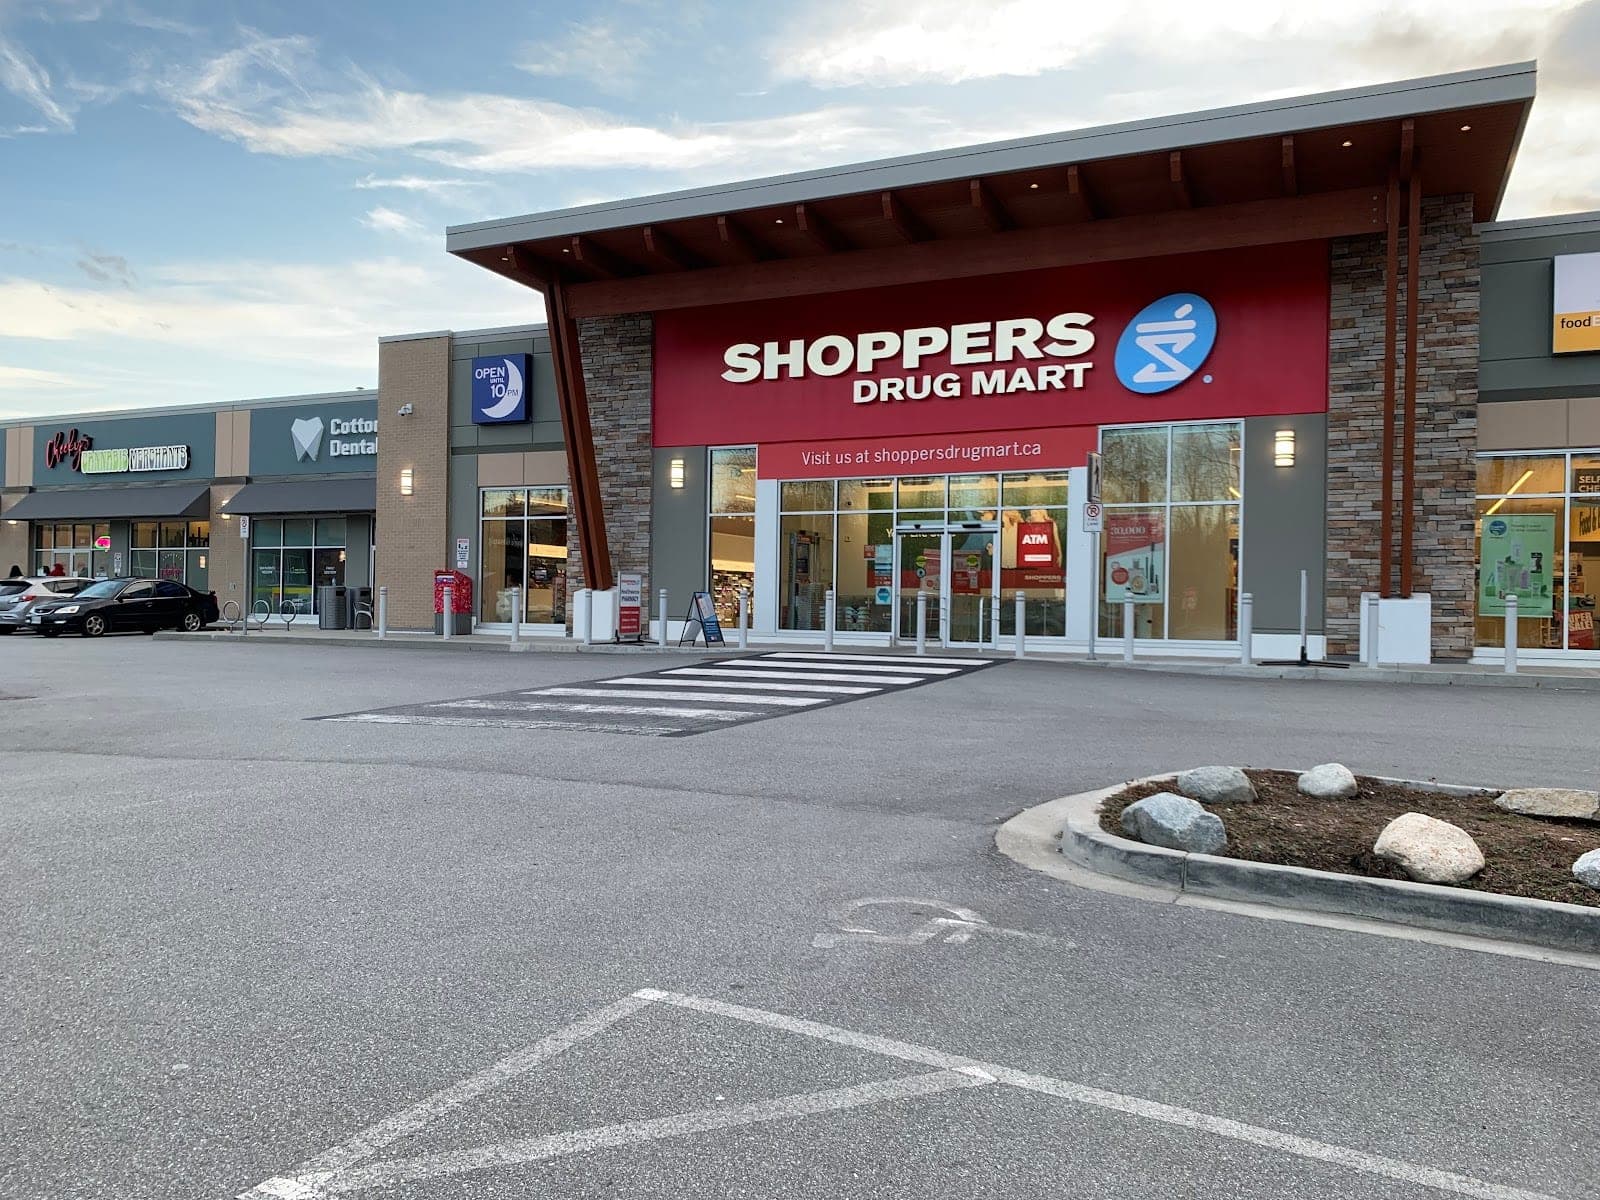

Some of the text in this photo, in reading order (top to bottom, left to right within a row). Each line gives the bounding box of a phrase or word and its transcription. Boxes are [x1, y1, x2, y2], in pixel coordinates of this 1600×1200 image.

[721, 312, 1096, 384] SHOPPERS
[475, 366, 505, 379] OPEN
[853, 362, 1093, 405] DRUG MART
[491, 384, 506, 398] 10
[129, 445, 188, 472] MERCHANTS
[802, 441, 1042, 465] Visit us at shoppersdrugmart.ca
[1022, 534, 1049, 545] ATM
